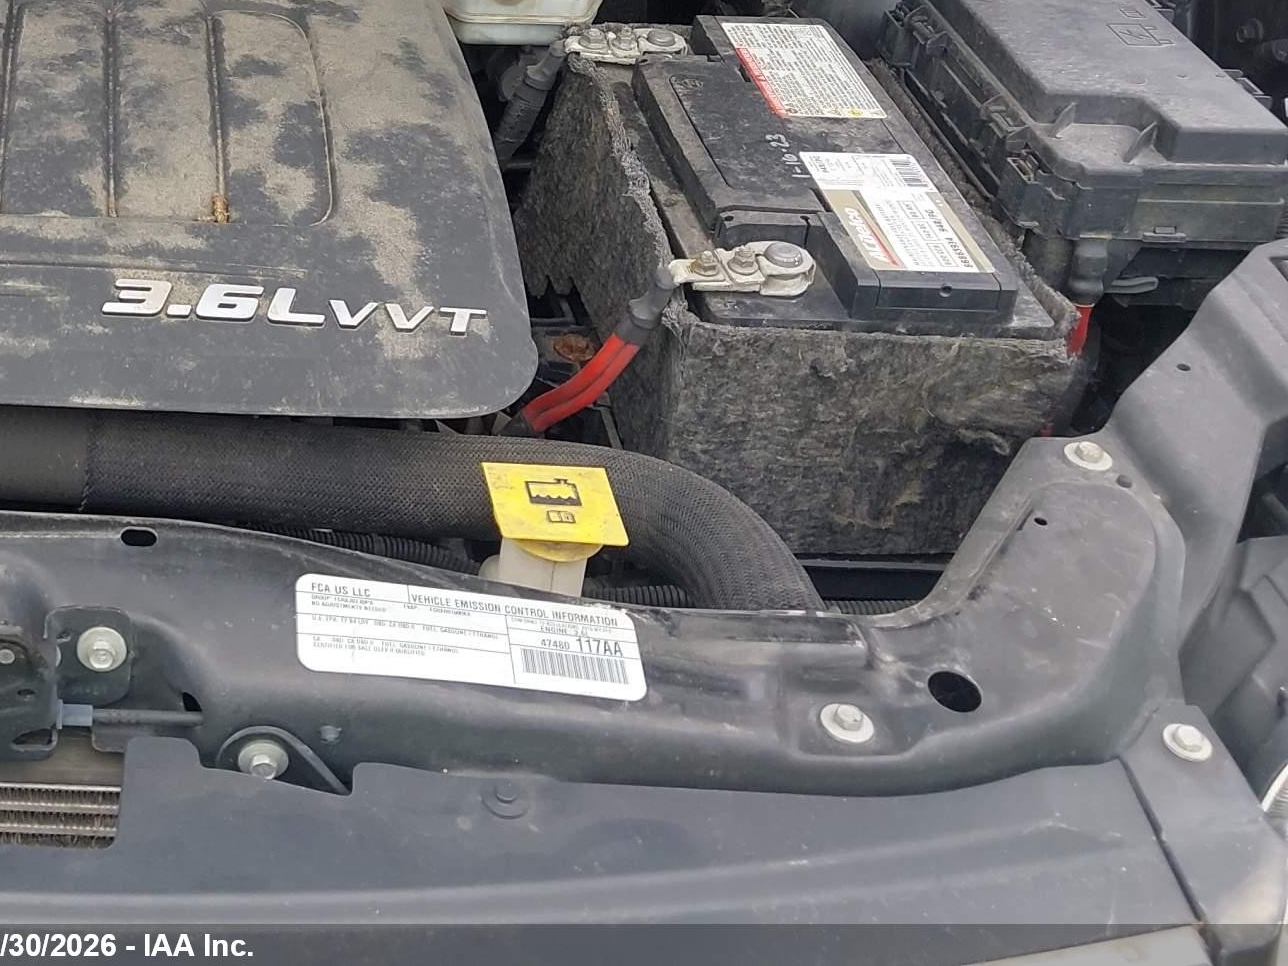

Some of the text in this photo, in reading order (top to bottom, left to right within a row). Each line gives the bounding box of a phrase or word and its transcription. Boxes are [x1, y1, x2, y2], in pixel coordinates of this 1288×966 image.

[311, 582, 370, 597] FCA US LLC
[411, 593, 452, 606] VEHICLE
[455, 598, 502, 612] EMISSION
[505, 604, 548, 619] CONTROL
[552, 610, 618, 626] INFORMATION
[576, 637, 624, 656] 117AA
